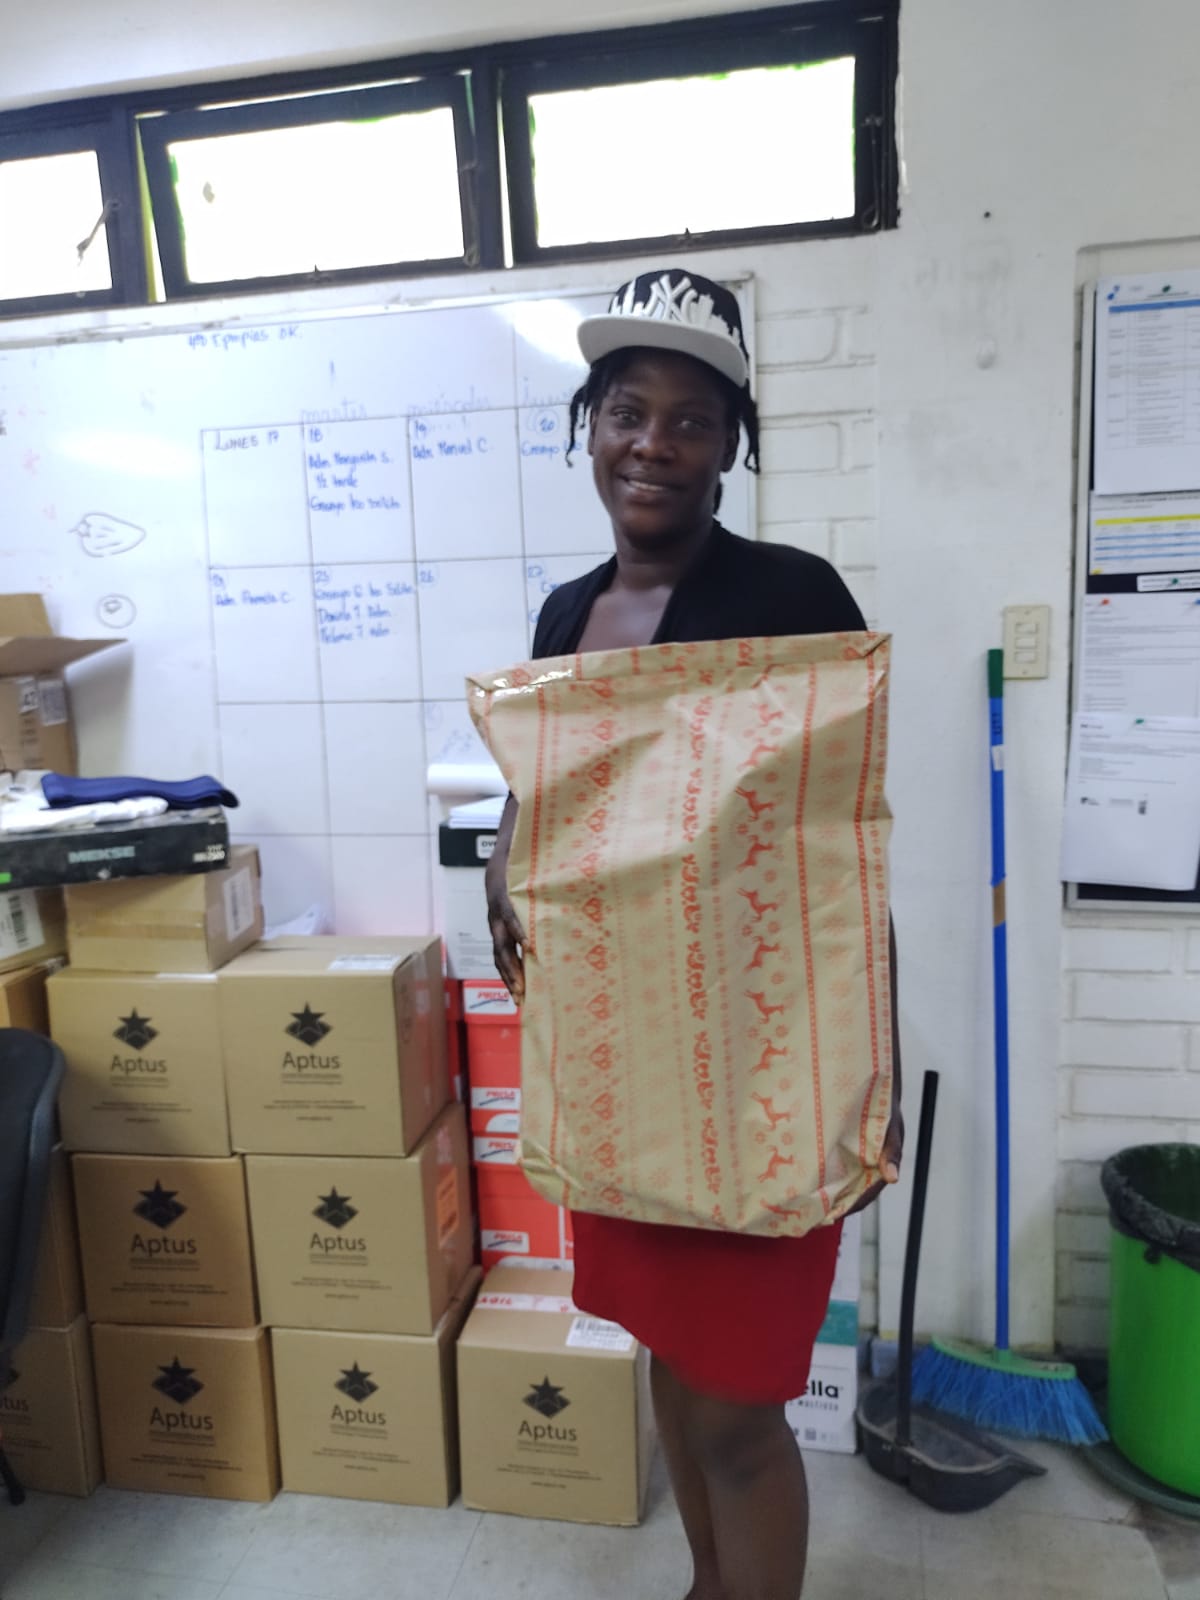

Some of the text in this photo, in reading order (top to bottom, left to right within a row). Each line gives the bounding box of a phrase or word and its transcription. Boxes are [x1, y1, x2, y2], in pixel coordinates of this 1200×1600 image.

[111, 1055, 167, 1075] Aptus
[282, 1051, 341, 1072] Aptus
[131, 1233, 198, 1257] Aptus
[310, 1232, 366, 1253] Aptus
[150, 1406, 214, 1431] Aptus
[331, 1404, 386, 1425] Aptus
[518, 1420, 578, 1442] Aptus
